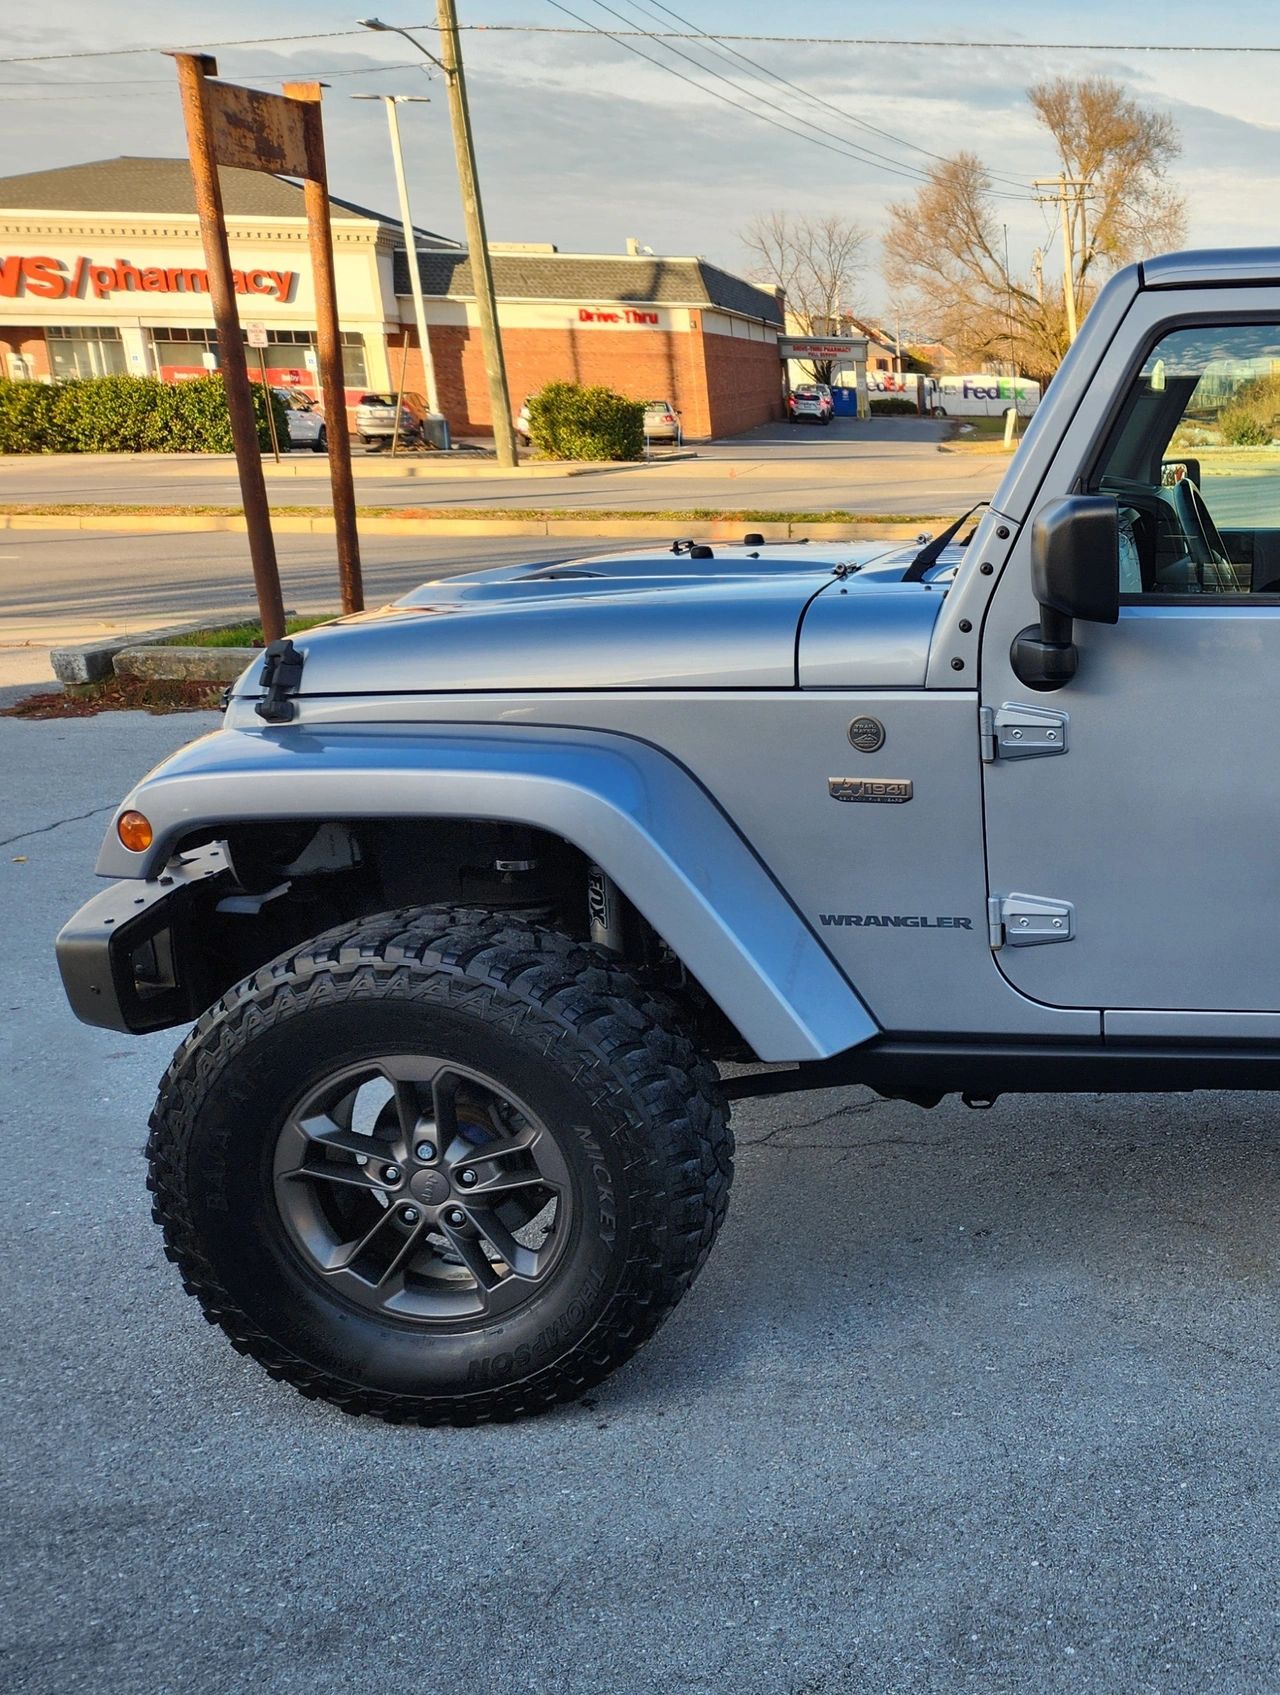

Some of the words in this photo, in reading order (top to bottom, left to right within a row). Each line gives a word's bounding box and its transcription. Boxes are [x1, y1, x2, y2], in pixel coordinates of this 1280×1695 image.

[578, 307, 660, 325] Drive-Thru
[866, 374, 907, 393] edEx
[963, 380, 1026, 400] FedEx
[865, 783, 906, 795] 1941
[819, 914, 974, 930] WRANGLER
[573, 1124, 617, 1252] MICKEY
[467, 1265, 608, 1384] THOMPSON
